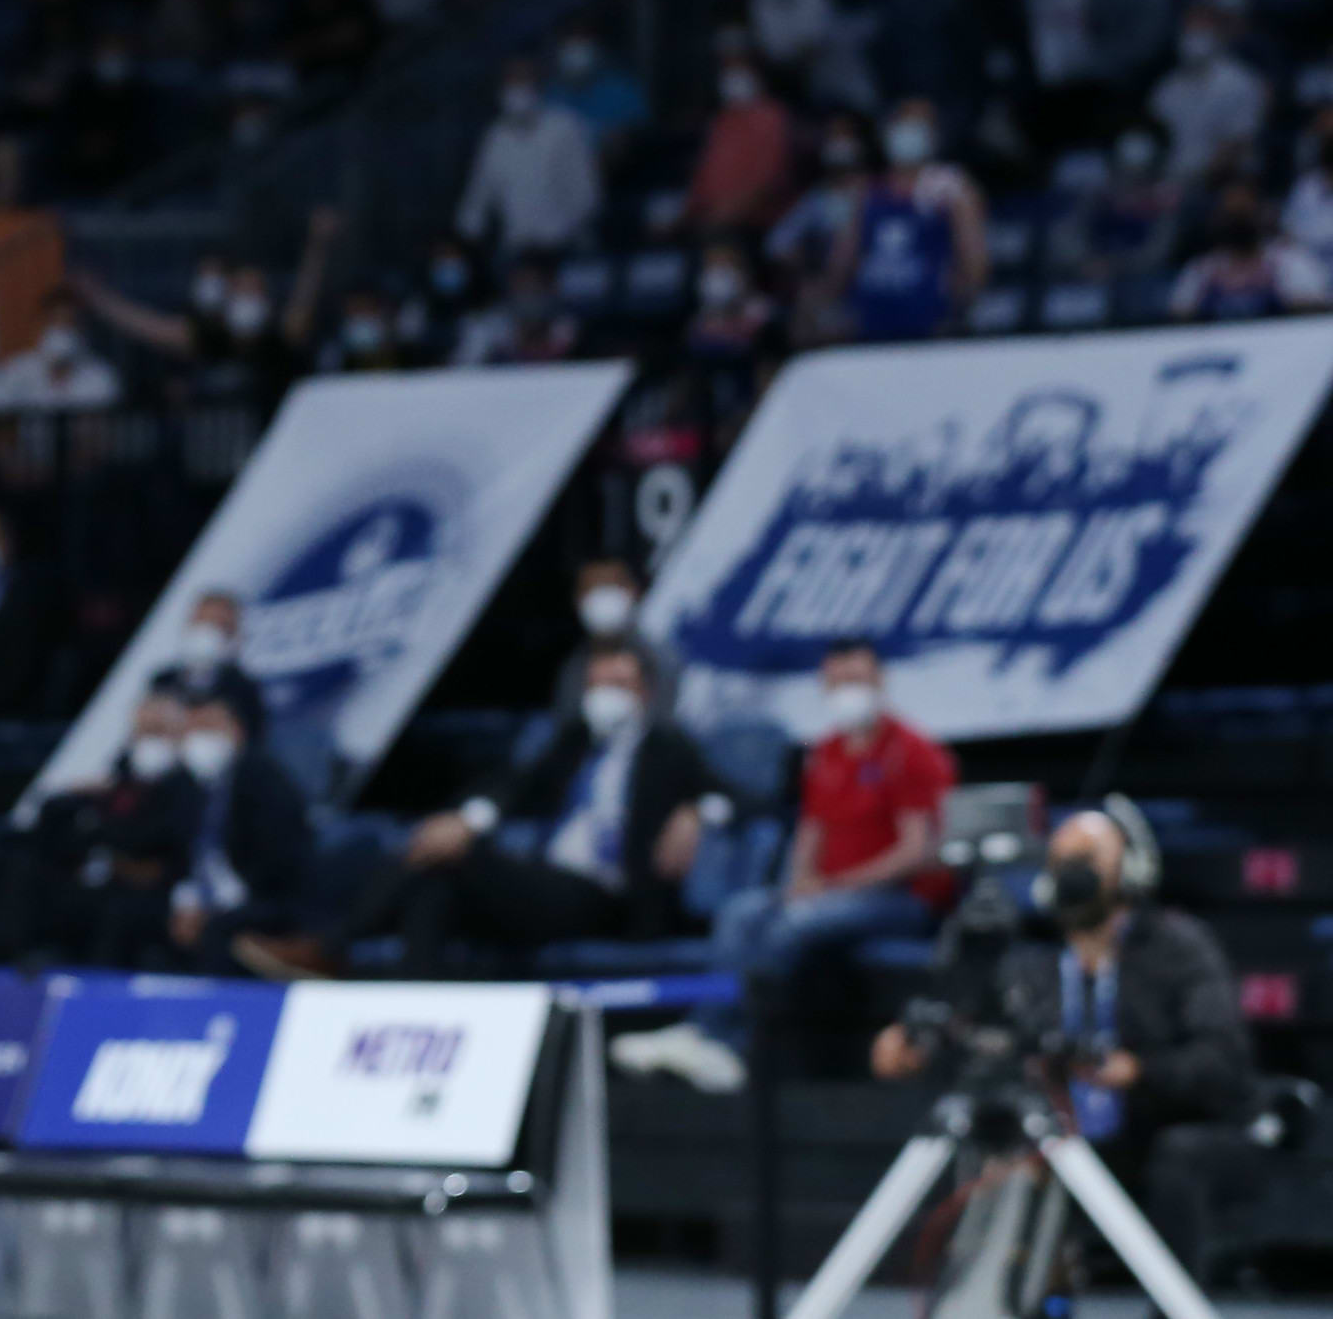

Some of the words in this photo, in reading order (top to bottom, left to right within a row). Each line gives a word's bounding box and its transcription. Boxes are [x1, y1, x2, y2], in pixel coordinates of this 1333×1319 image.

[735, 520, 951, 639] FIGHT
[909, 508, 1075, 634] FOR
[1037, 499, 1168, 627] US
